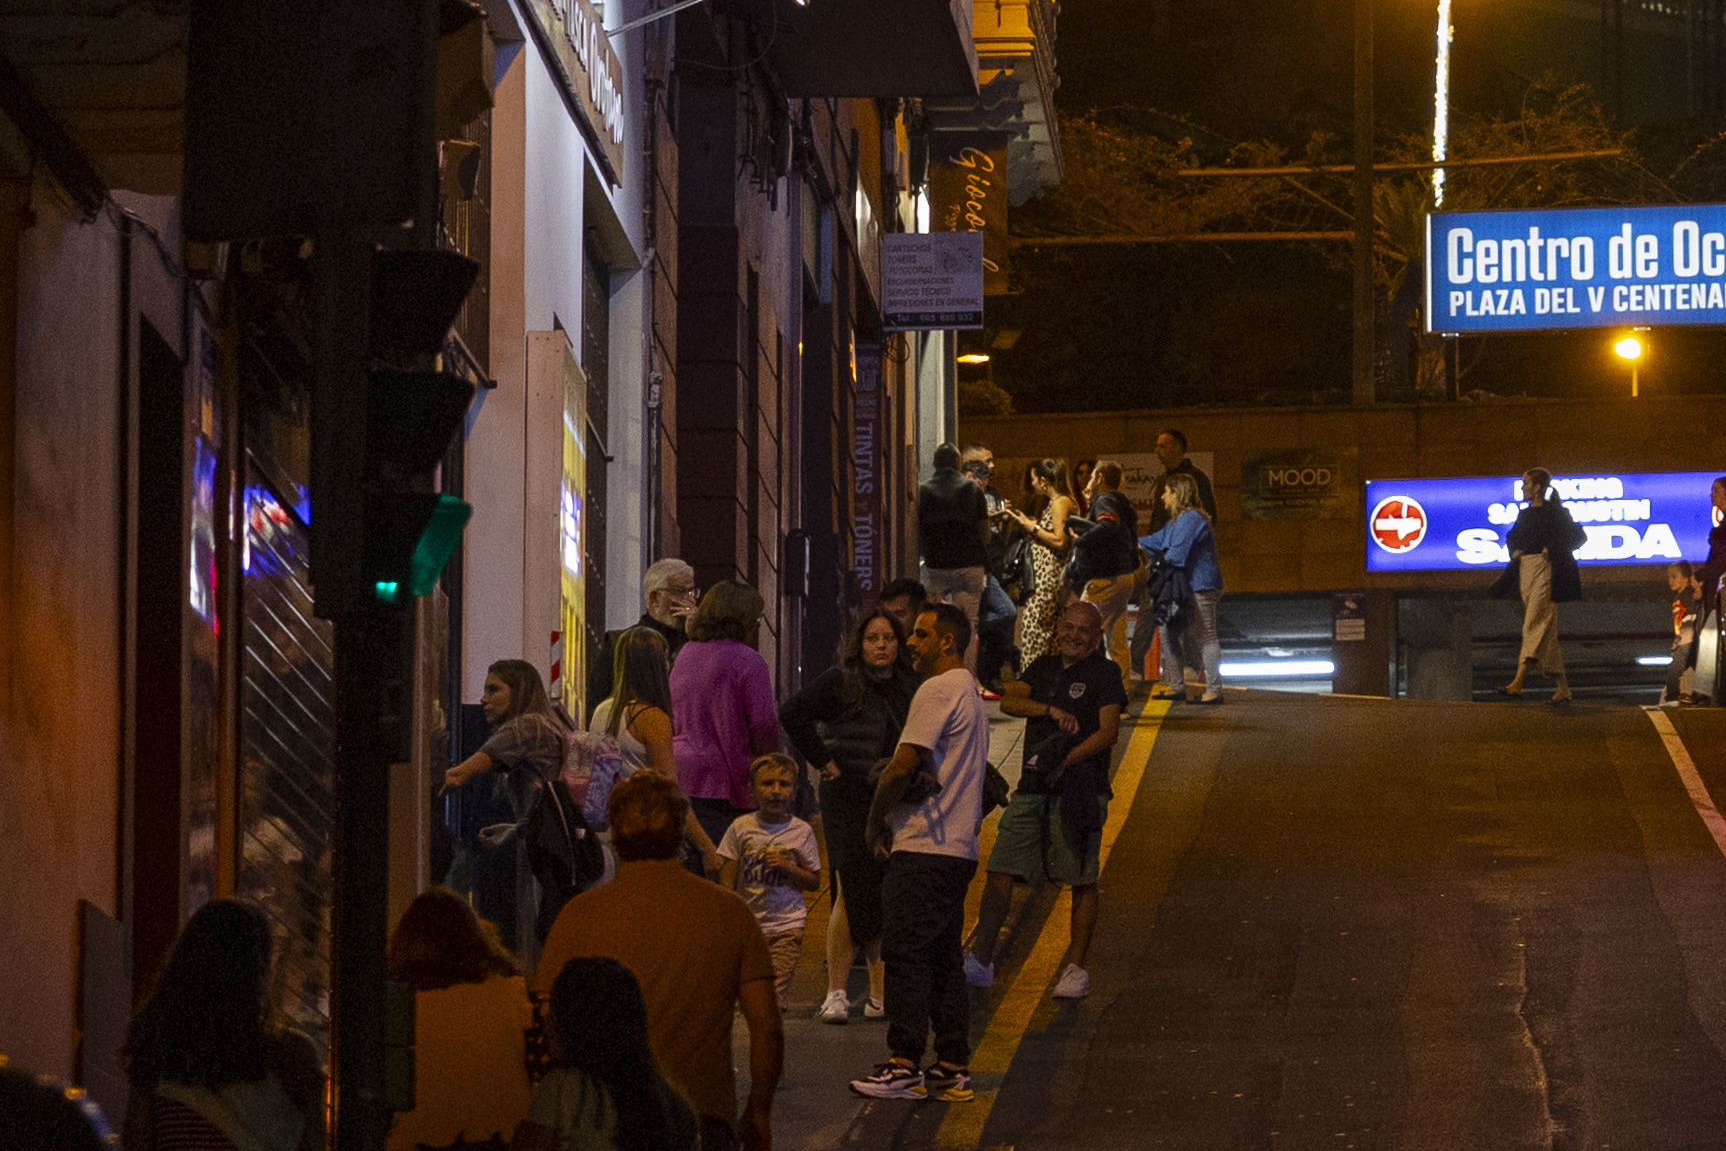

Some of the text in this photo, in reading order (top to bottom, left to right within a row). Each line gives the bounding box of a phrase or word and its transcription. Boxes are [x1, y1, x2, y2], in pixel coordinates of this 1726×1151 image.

[1447, 226, 1595, 284] Centro
[1608, 222, 1659, 280] de
[1449, 288, 1526, 317] PLAZA
[1535, 286, 1581, 314] DEL
[1587, 286, 1605, 312] V
[855, 422, 874, 494] TINTAS
[1268, 468, 1331, 486] MOOD
[1513, 477, 1623, 501] PRKING
[1455, 523, 1683, 564] SIDA
